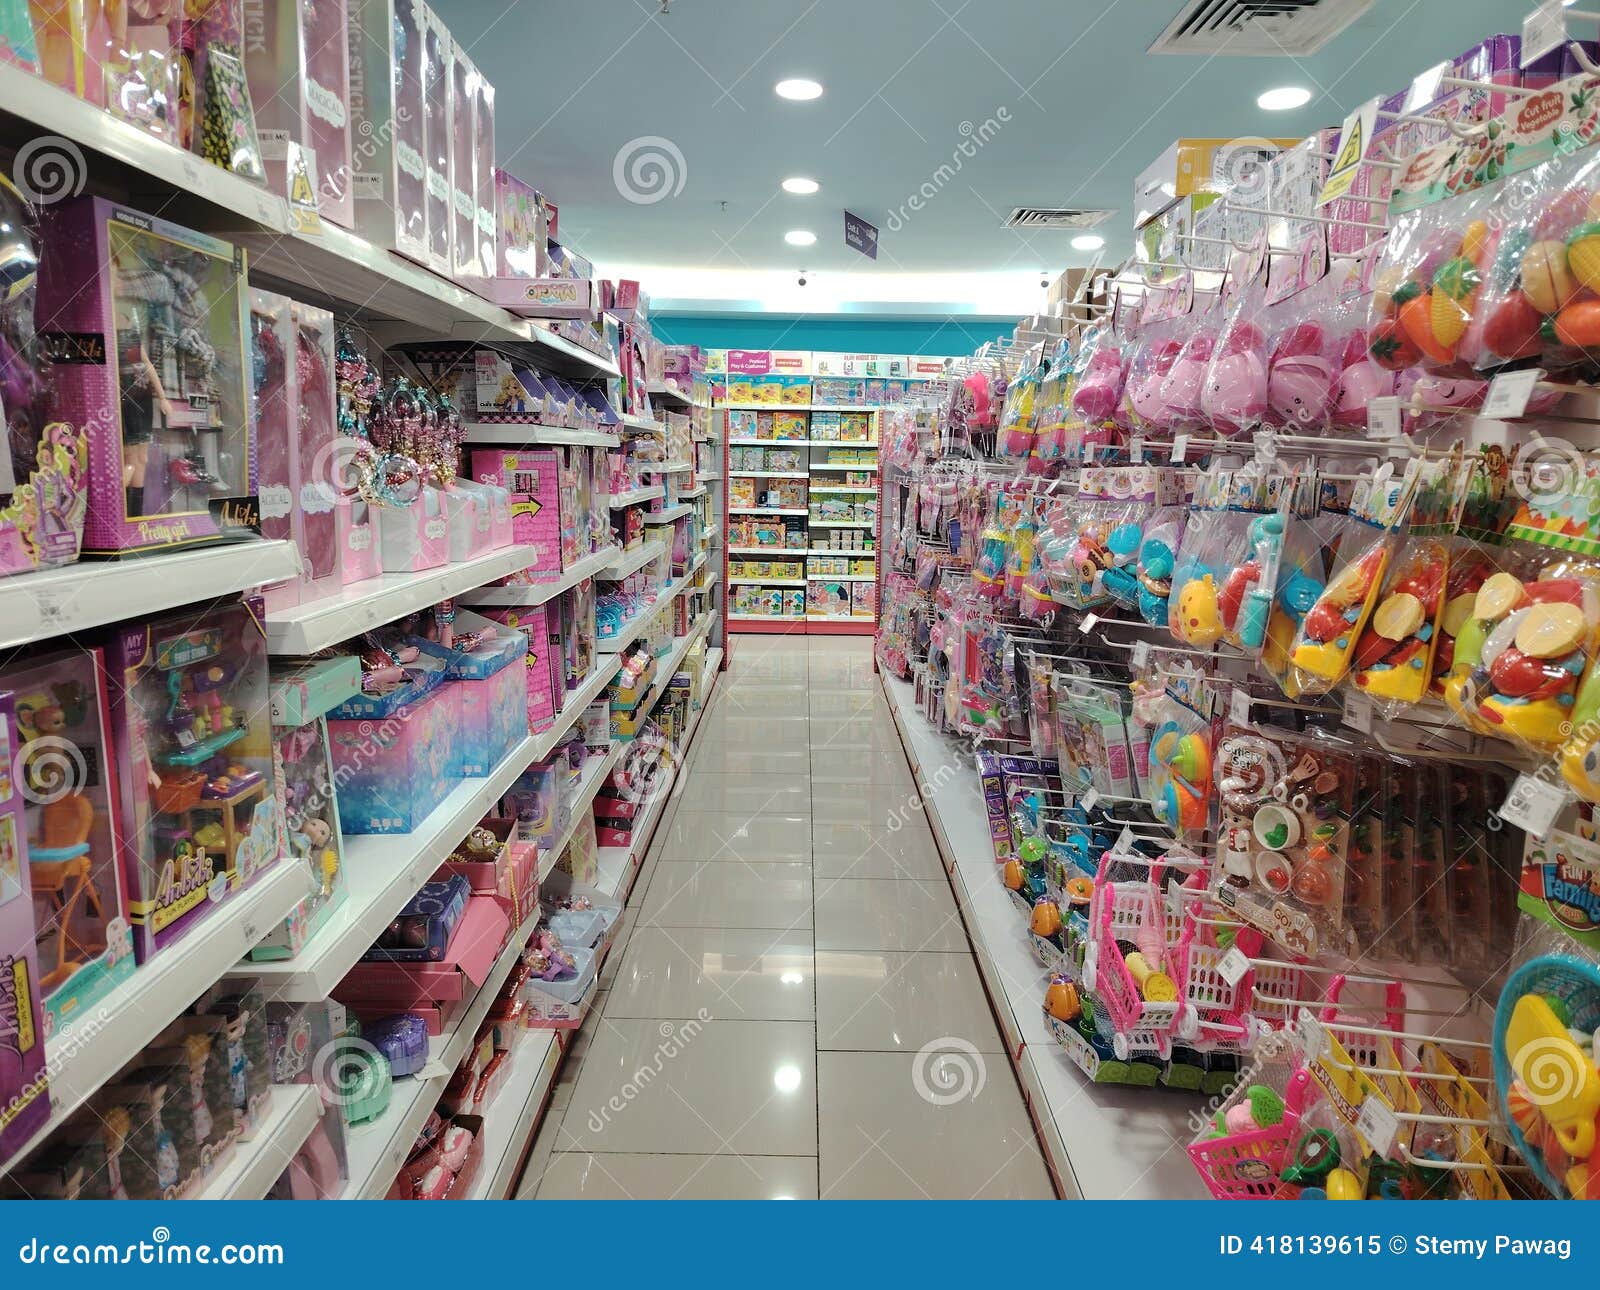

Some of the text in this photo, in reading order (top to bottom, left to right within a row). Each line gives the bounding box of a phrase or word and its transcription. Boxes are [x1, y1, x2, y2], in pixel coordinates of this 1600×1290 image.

[245, 0, 266, 55] TICK
[137, 520, 190, 543] Pretty girl
[126, 633, 143, 649] MY
[1222, 741, 1263, 765] Cutlery
[1232, 756, 1251, 770] Set
[1273, 908, 1292, 928] GO!
[1310, 1060, 1355, 1122] PLAY HOUSE
